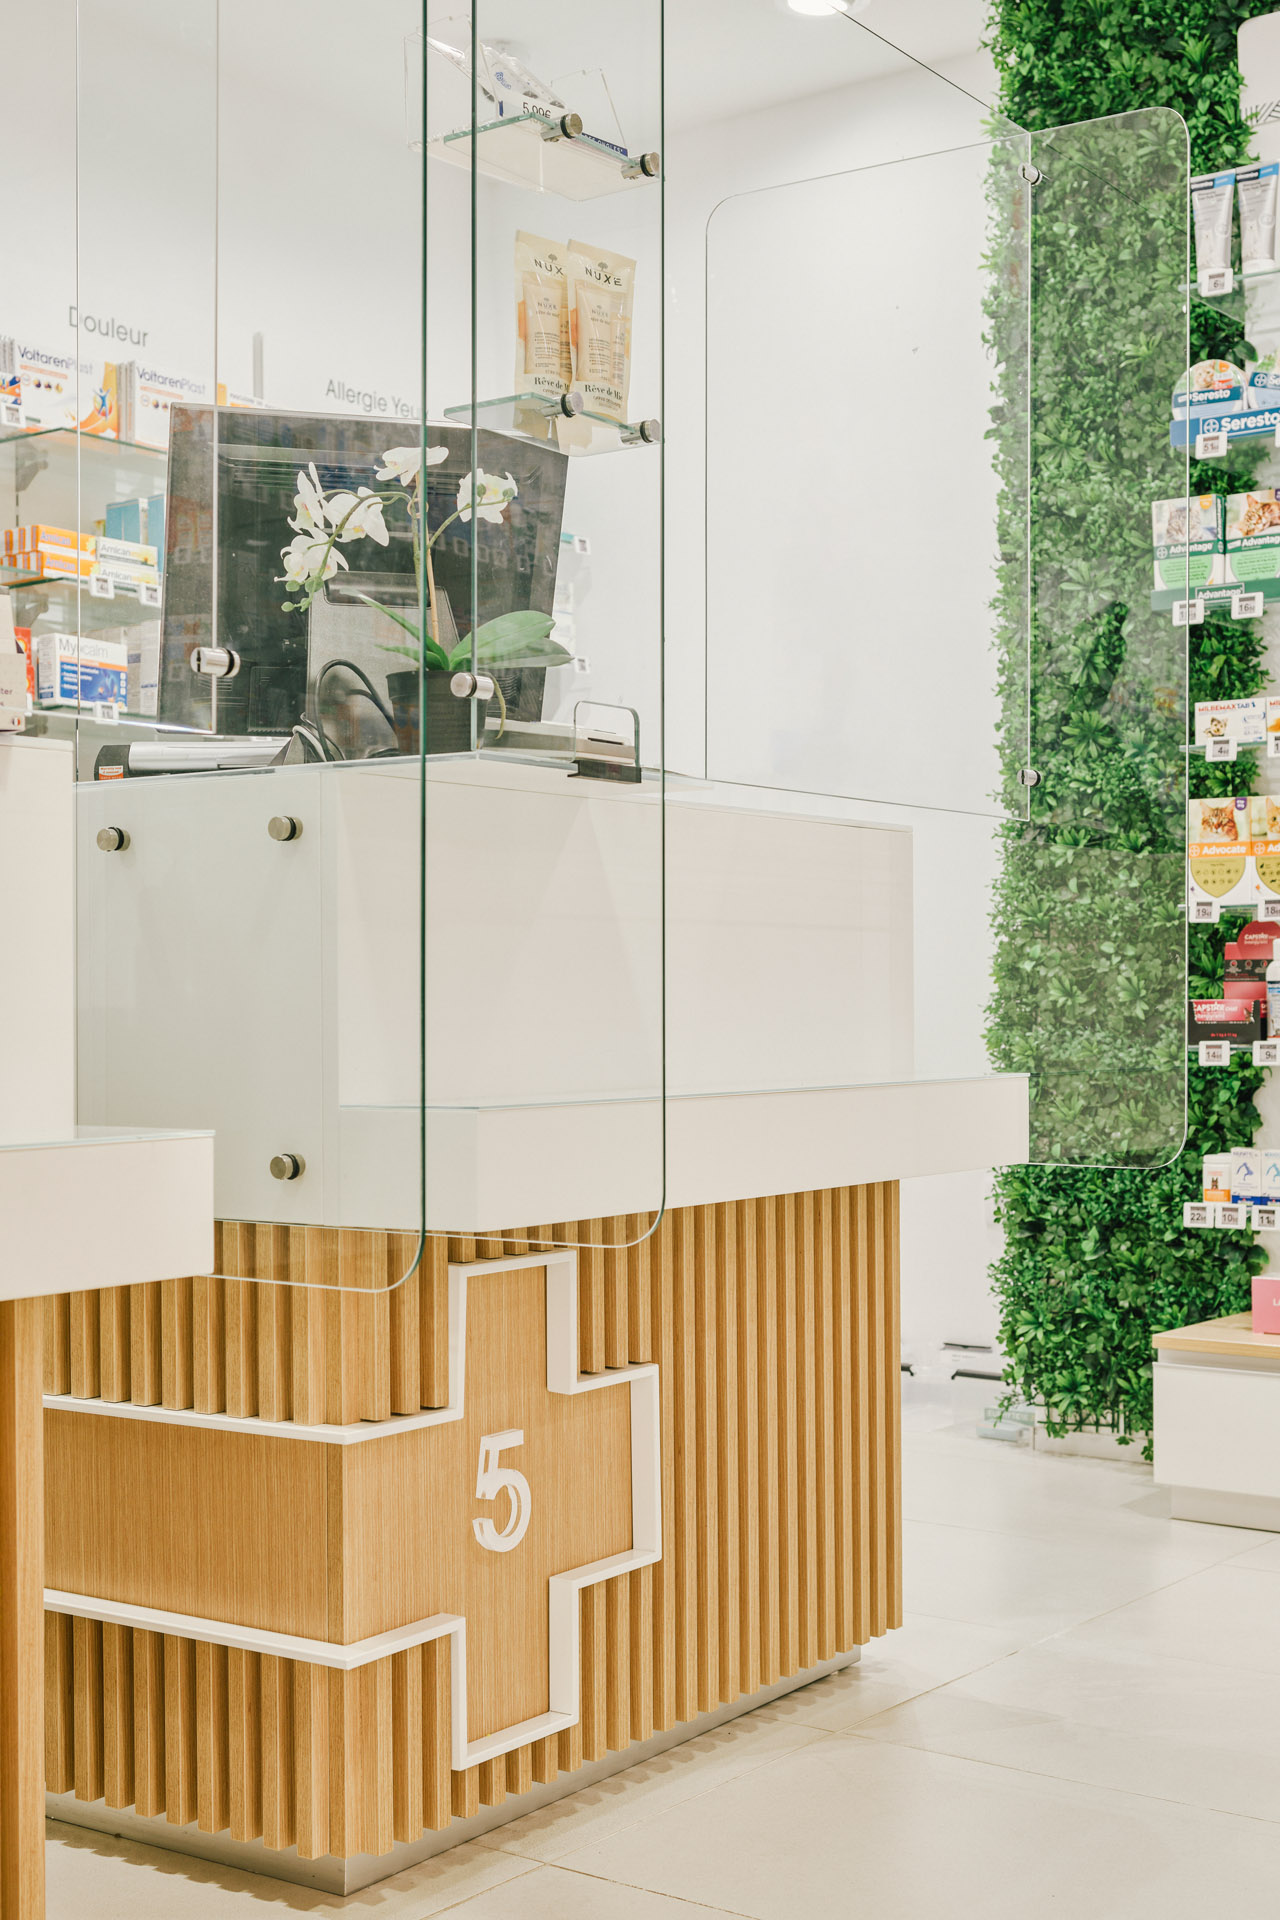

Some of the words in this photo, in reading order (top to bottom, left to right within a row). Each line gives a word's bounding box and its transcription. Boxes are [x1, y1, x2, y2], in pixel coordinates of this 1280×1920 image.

[585, 266, 622, 287] NUXE
[69, 306, 148, 347] Douleur
[136, 366, 206, 395] VoltarenPlast
[325, 379, 388, 413] Allergie
[1192, 389, 1231, 402] Seresto
[1221, 411, 1280, 432] Seresto
[1169, 543, 1212, 554] Advntage
[59, 638, 109, 659] Mycalm
[1202, 844, 1247, 855] Advocate
[472, 1428, 532, 1553] 5
